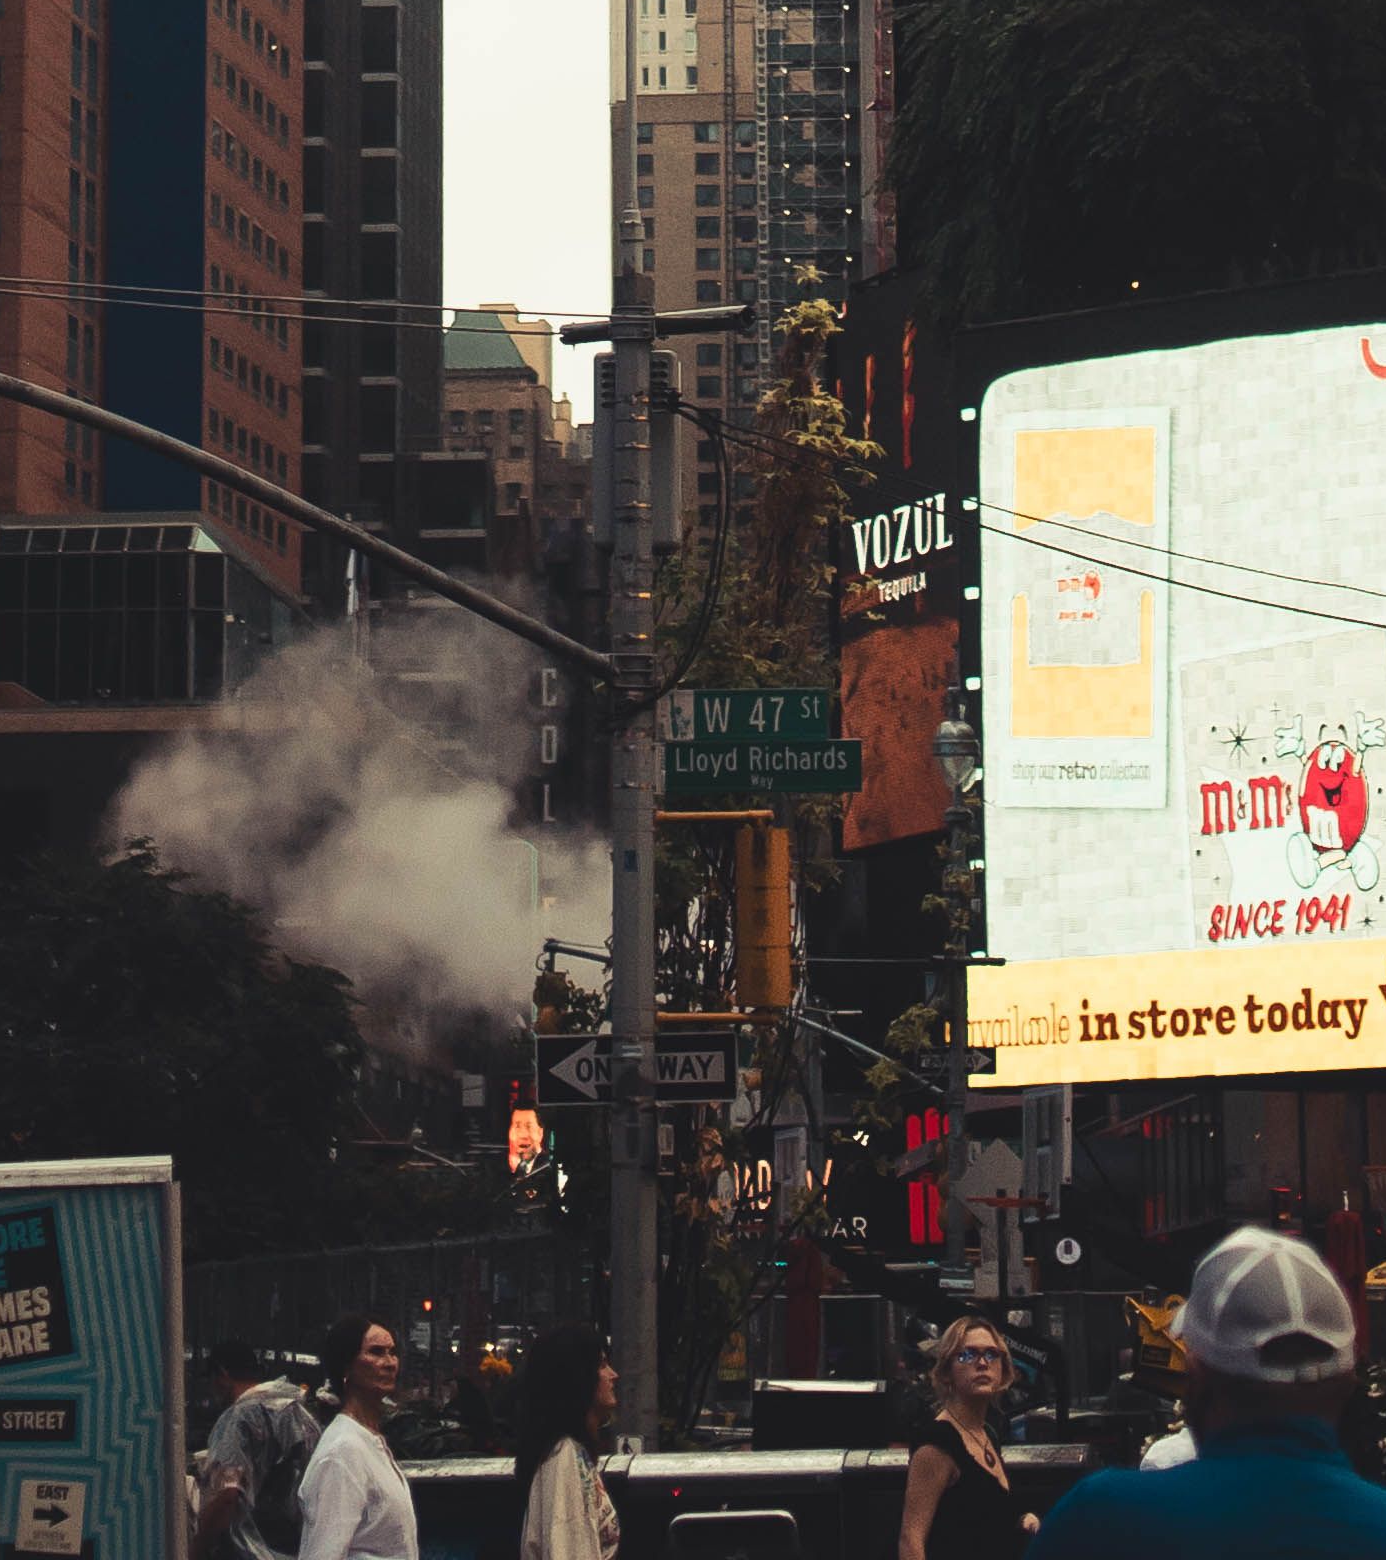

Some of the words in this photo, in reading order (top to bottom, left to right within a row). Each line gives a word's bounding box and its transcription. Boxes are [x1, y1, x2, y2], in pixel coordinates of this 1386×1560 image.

[703, 696, 731, 733] W
[748, 696, 785, 733] 47
[800, 695, 821, 720] St
[675, 747, 738, 779] Lloyd
[748, 744, 848, 771] Richards
[1058, 760, 1098, 780] retro
[1207, 898, 1287, 943] SINCE
[1294, 893, 1352, 935] 1941
[1079, 999, 1121, 1042] in
[1127, 998, 1236, 1040] store
[1243, 987, 1368, 1040] today
[575, 1057, 612, 1082] ON
[656, 1055, 714, 1081] WAY
[2, 1410, 67, 1431] STREET
[35, 1483, 70, 1501] EAST
